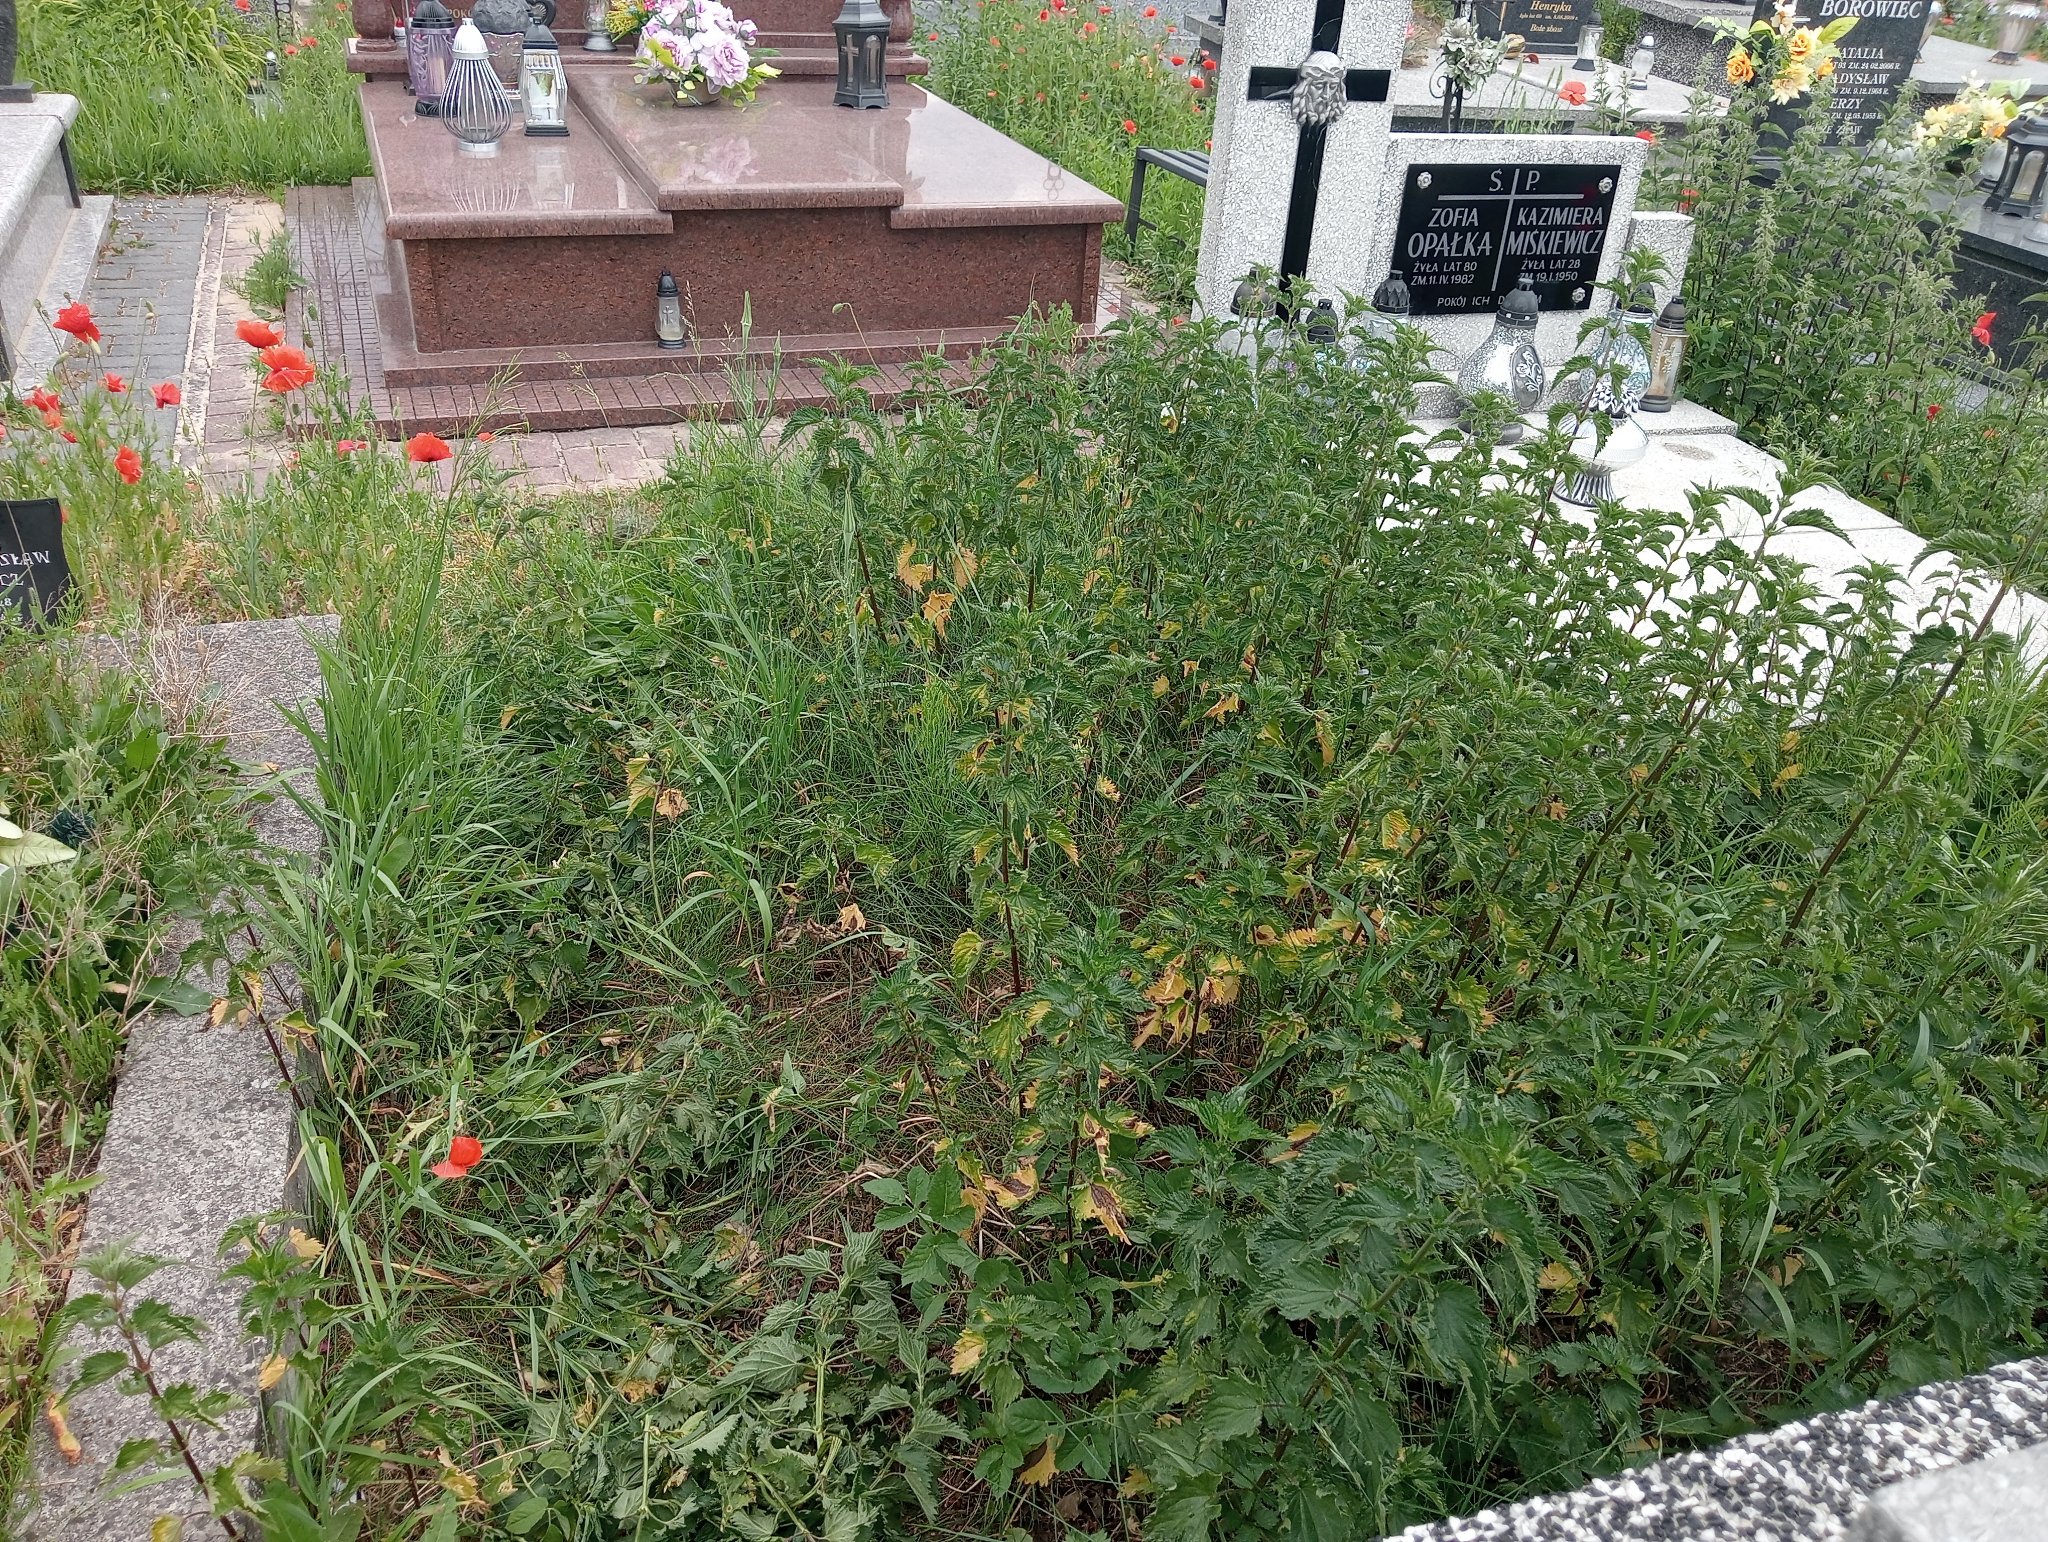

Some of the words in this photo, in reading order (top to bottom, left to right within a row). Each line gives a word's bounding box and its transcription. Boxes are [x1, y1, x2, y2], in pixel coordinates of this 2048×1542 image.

[1530, 0, 1572, 13] Henryka
[1819, 0, 1922, 19] BOROWIEC
[1840, 47, 1884, 60] ATALIA
[1830, 98, 1864, 110] ERZY
[1525, 170, 1540, 191] P.
[1428, 207, 1479, 228] ZOFIA
[1516, 206, 1603, 226] KAZIMIERA
[1407, 231, 1493, 258] OPAŁKA
[1505, 229, 1605, 255] MIŚKIEWICZ
[1413, 260, 1439, 273] ŻYŁA
[1443, 261, 1462, 272] LAT
[1463, 261, 1478, 272] 80
[1521, 257, 1545, 270] ŻYŁA
[1549, 259, 1567, 269] LAT
[1567, 258, 1581, 269] 28
[1437, 295, 1467, 308] POKÓJ
[1471, 296, 1491, 306] ICH
